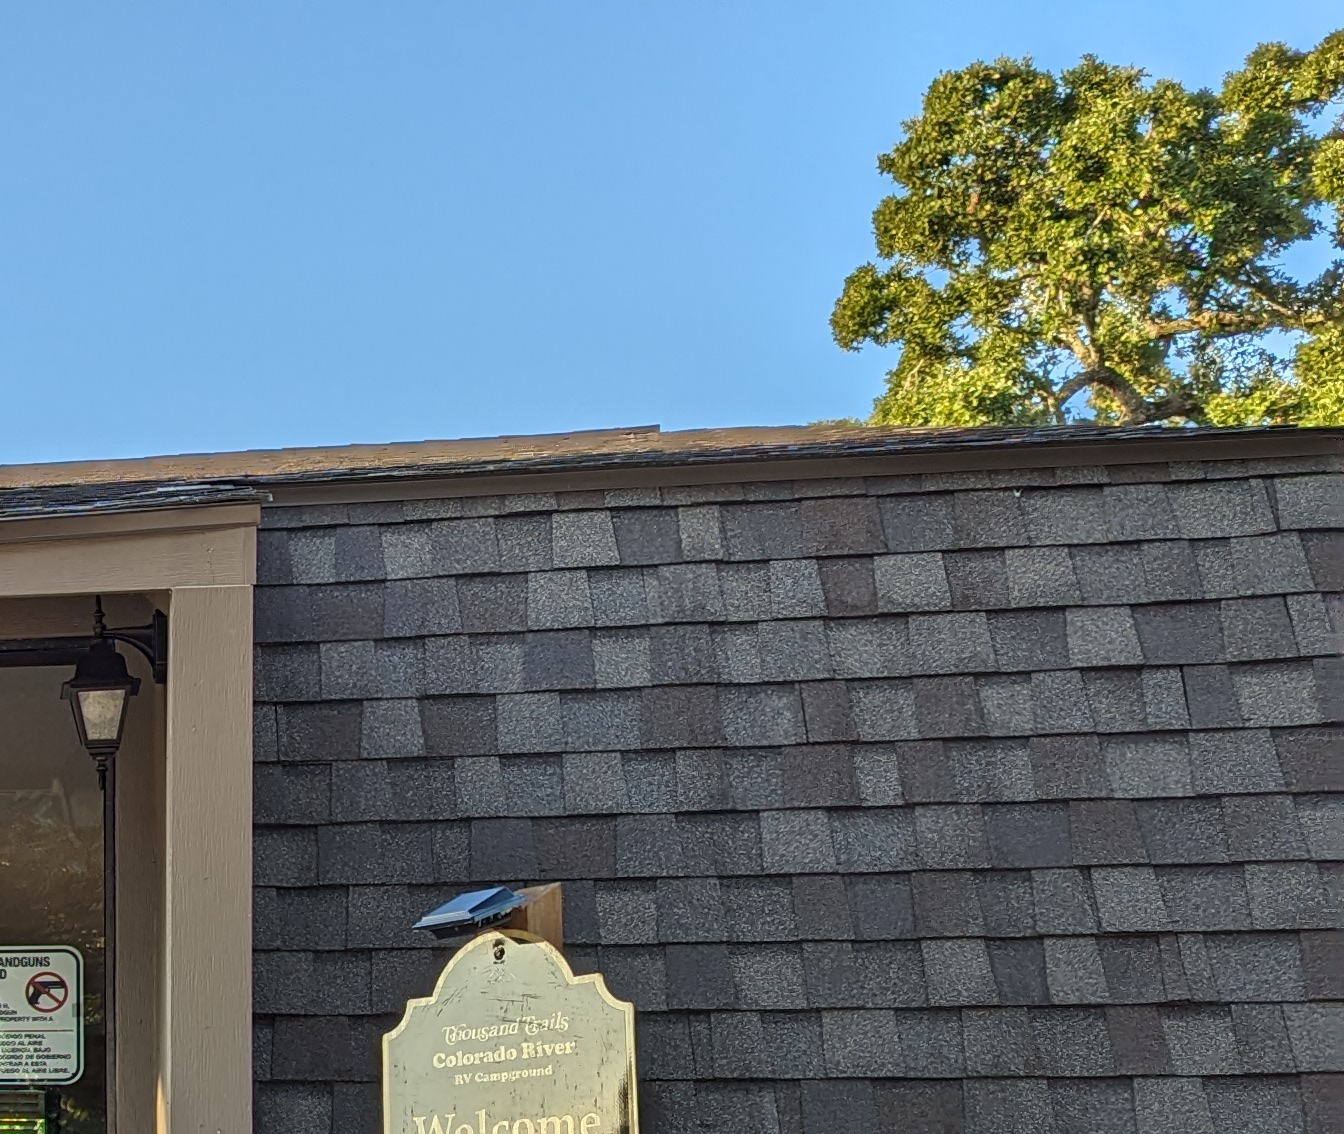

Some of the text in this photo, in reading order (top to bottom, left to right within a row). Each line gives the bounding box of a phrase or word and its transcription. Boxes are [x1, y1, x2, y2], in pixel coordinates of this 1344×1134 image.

[442, 1011, 569, 1045] Thousand Trails
[432, 1040, 576, 1069] Colorado River
[454, 1065, 554, 1085] RV Campground
